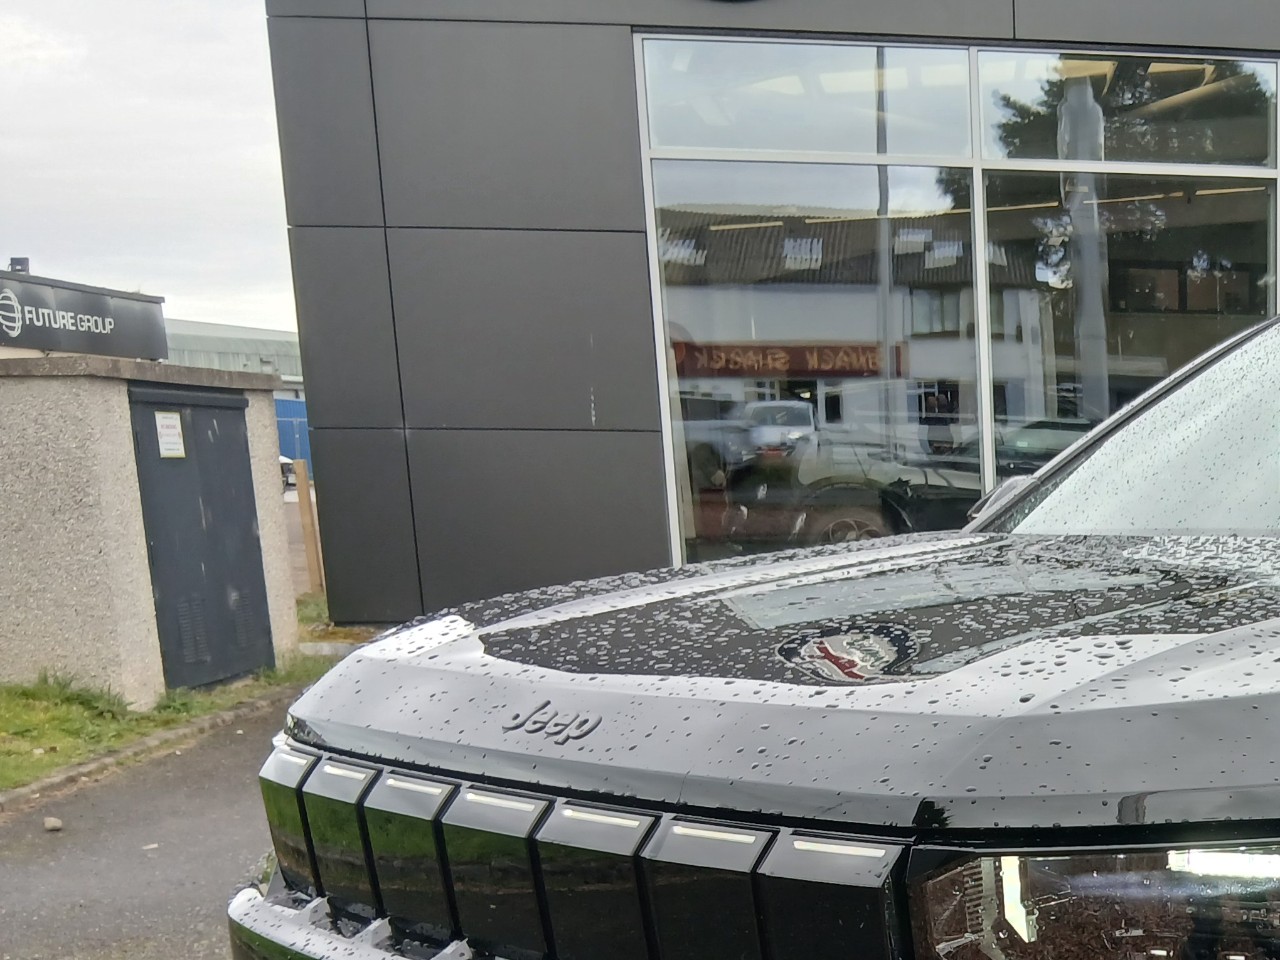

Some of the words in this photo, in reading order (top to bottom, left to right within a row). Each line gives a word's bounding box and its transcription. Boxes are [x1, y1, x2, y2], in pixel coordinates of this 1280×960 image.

[24, 305, 77, 331] FUTURE
[76, 313, 115, 334] GROUP
[501, 699, 603, 746] Jeep
